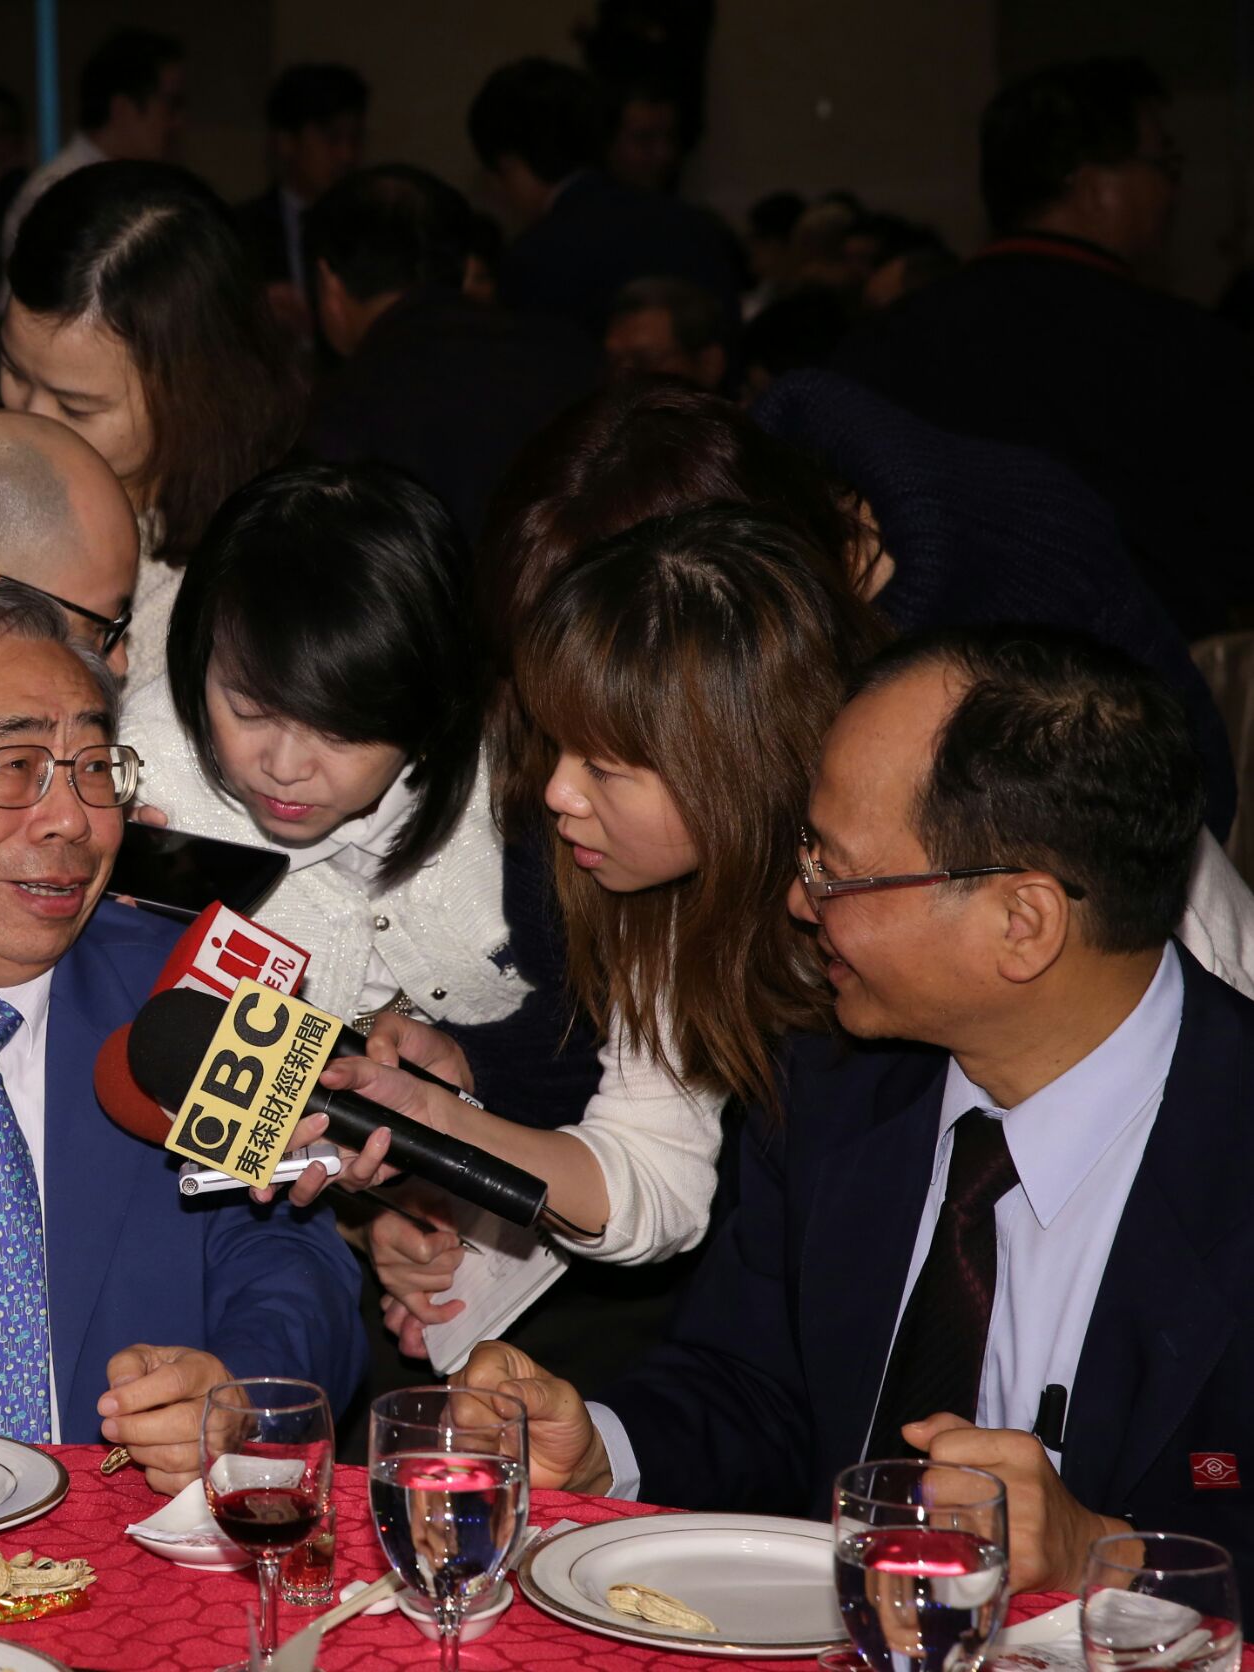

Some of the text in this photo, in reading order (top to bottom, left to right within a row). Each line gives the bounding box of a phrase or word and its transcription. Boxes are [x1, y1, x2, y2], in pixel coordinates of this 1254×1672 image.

[234, 1012, 332, 1180] 東森財經新聞
